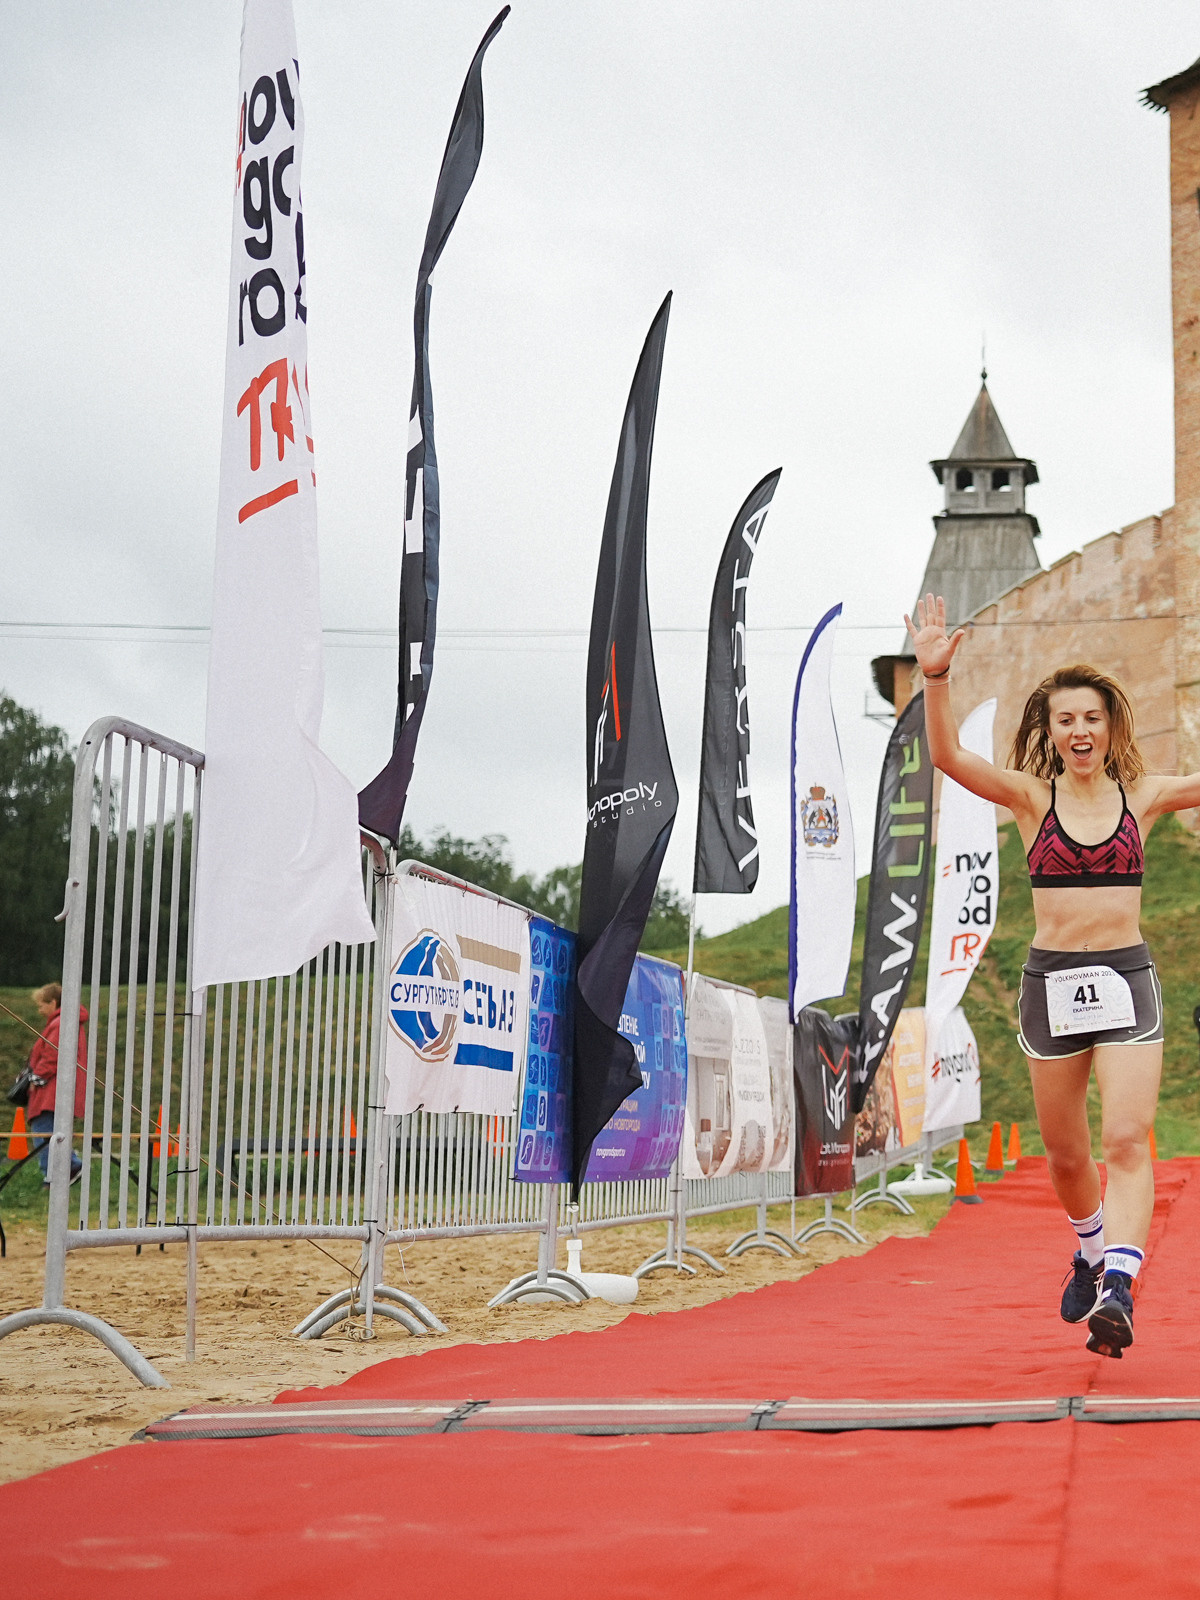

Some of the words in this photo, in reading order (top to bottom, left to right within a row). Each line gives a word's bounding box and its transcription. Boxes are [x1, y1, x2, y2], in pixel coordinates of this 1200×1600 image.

[588, 782, 658, 820] onopoly
[593, 800, 662, 828] studio
[1054, 971, 1099, 983] VOLKHOVMAN
[1074, 984, 1099, 1005] 41
[499, 989, 516, 1033] АЗ
